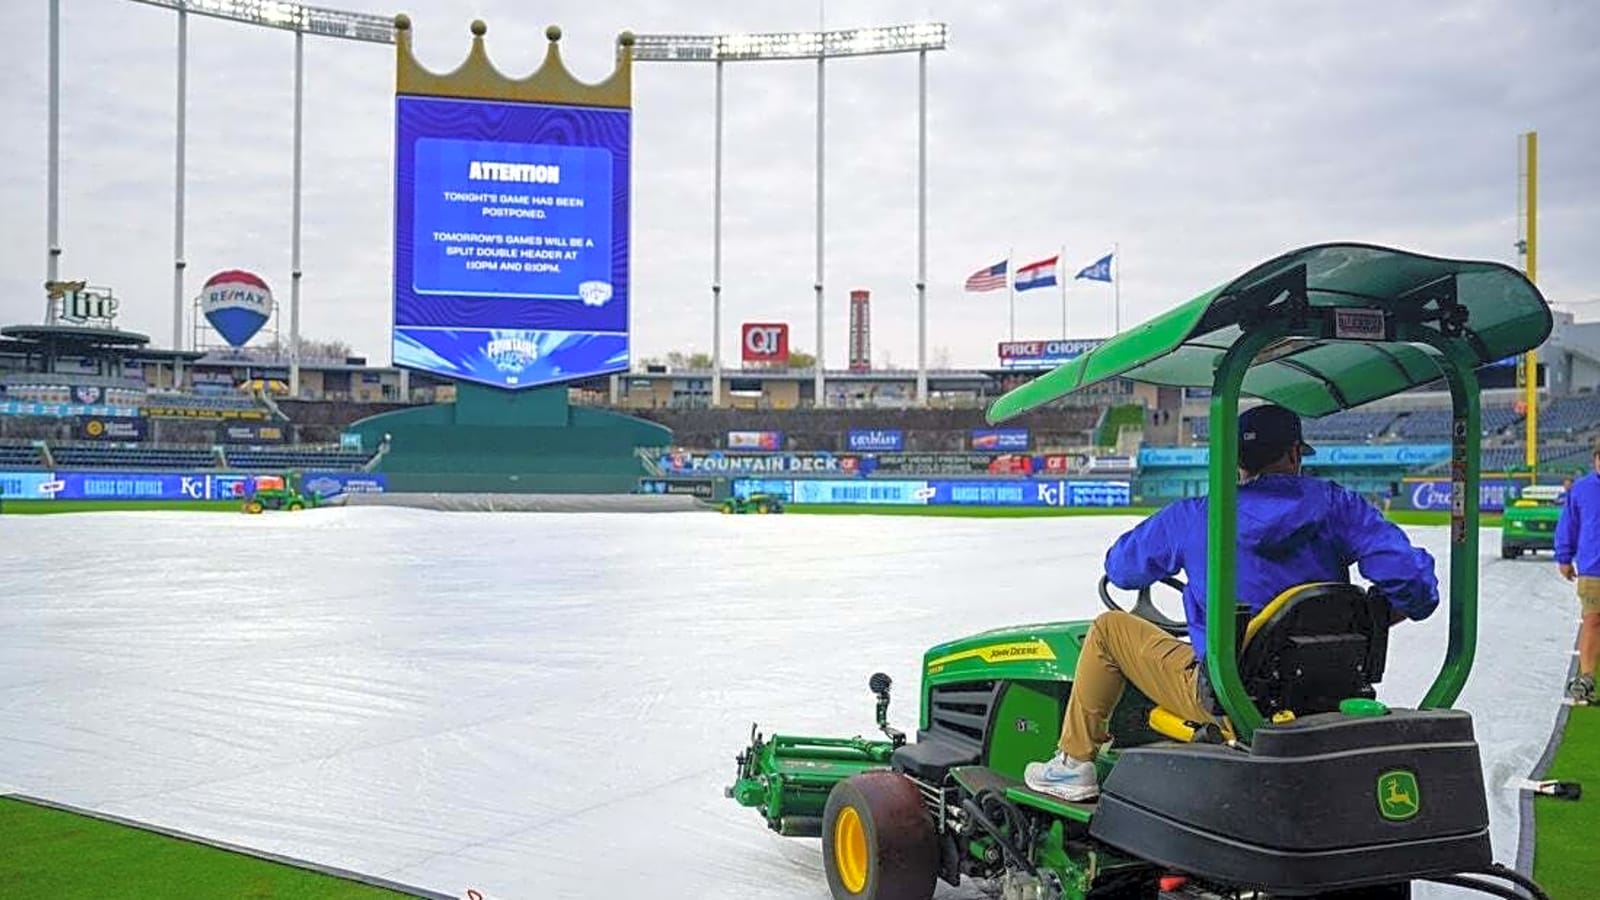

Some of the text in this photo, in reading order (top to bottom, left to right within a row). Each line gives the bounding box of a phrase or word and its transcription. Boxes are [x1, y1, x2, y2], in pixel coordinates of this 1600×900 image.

[469, 161, 560, 184] ATTENTION
[443, 191, 584, 207] TONIGHT'S GAME HAS BEEN
[482, 207, 546, 219] POSTPONED.
[433, 232, 594, 247] TOMORROW'S GAMES WILL BE A
[446, 246, 577, 260] SPLIT DOUBLE HEADER AT
[500, 262, 522, 272] AND
[210, 289, 265, 304] RE/MAX
[60, 287, 118, 324] Lite
[745, 326, 781, 354] QT
[1002, 343, 1041, 356] PRICE
[692, 457, 838, 472] FOUNTAIN DECK
[181, 477, 202, 499] KC
[1038, 483, 1057, 505] KC
[991, 647, 1039, 659] JOHN DEERE
